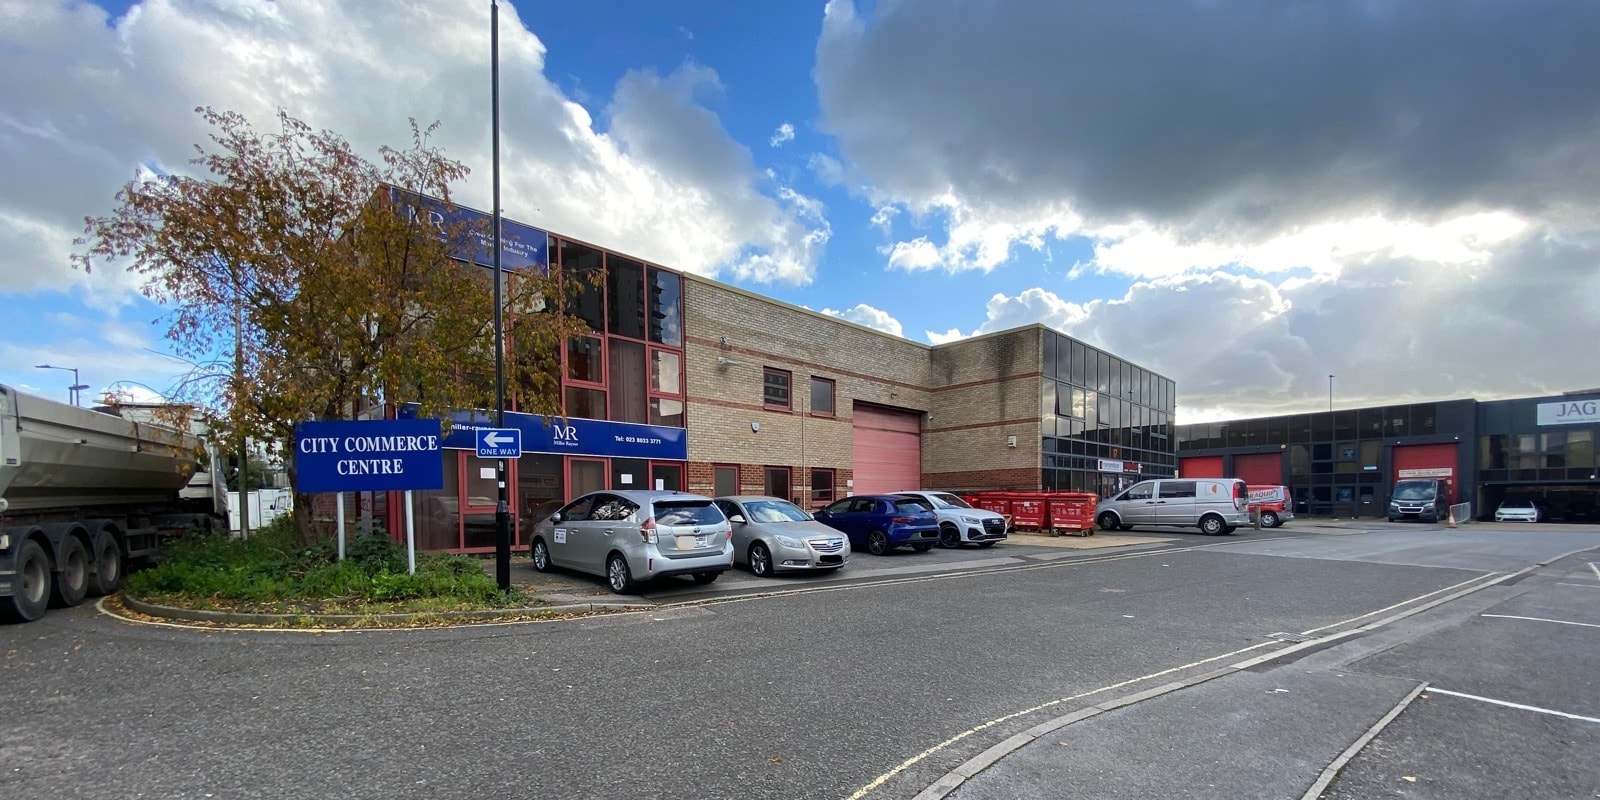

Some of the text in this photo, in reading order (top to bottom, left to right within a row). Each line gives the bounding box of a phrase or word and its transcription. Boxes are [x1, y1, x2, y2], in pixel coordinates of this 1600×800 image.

[503, 245, 528, 257] Industry
[514, 241, 525, 249] For
[526, 244, 537, 253] The
[1556, 401, 1597, 417] JAG
[553, 425, 578, 441] MR
[300, 435, 438, 453] CITY COMMERCE
[337, 459, 404, 475] CENTRE
